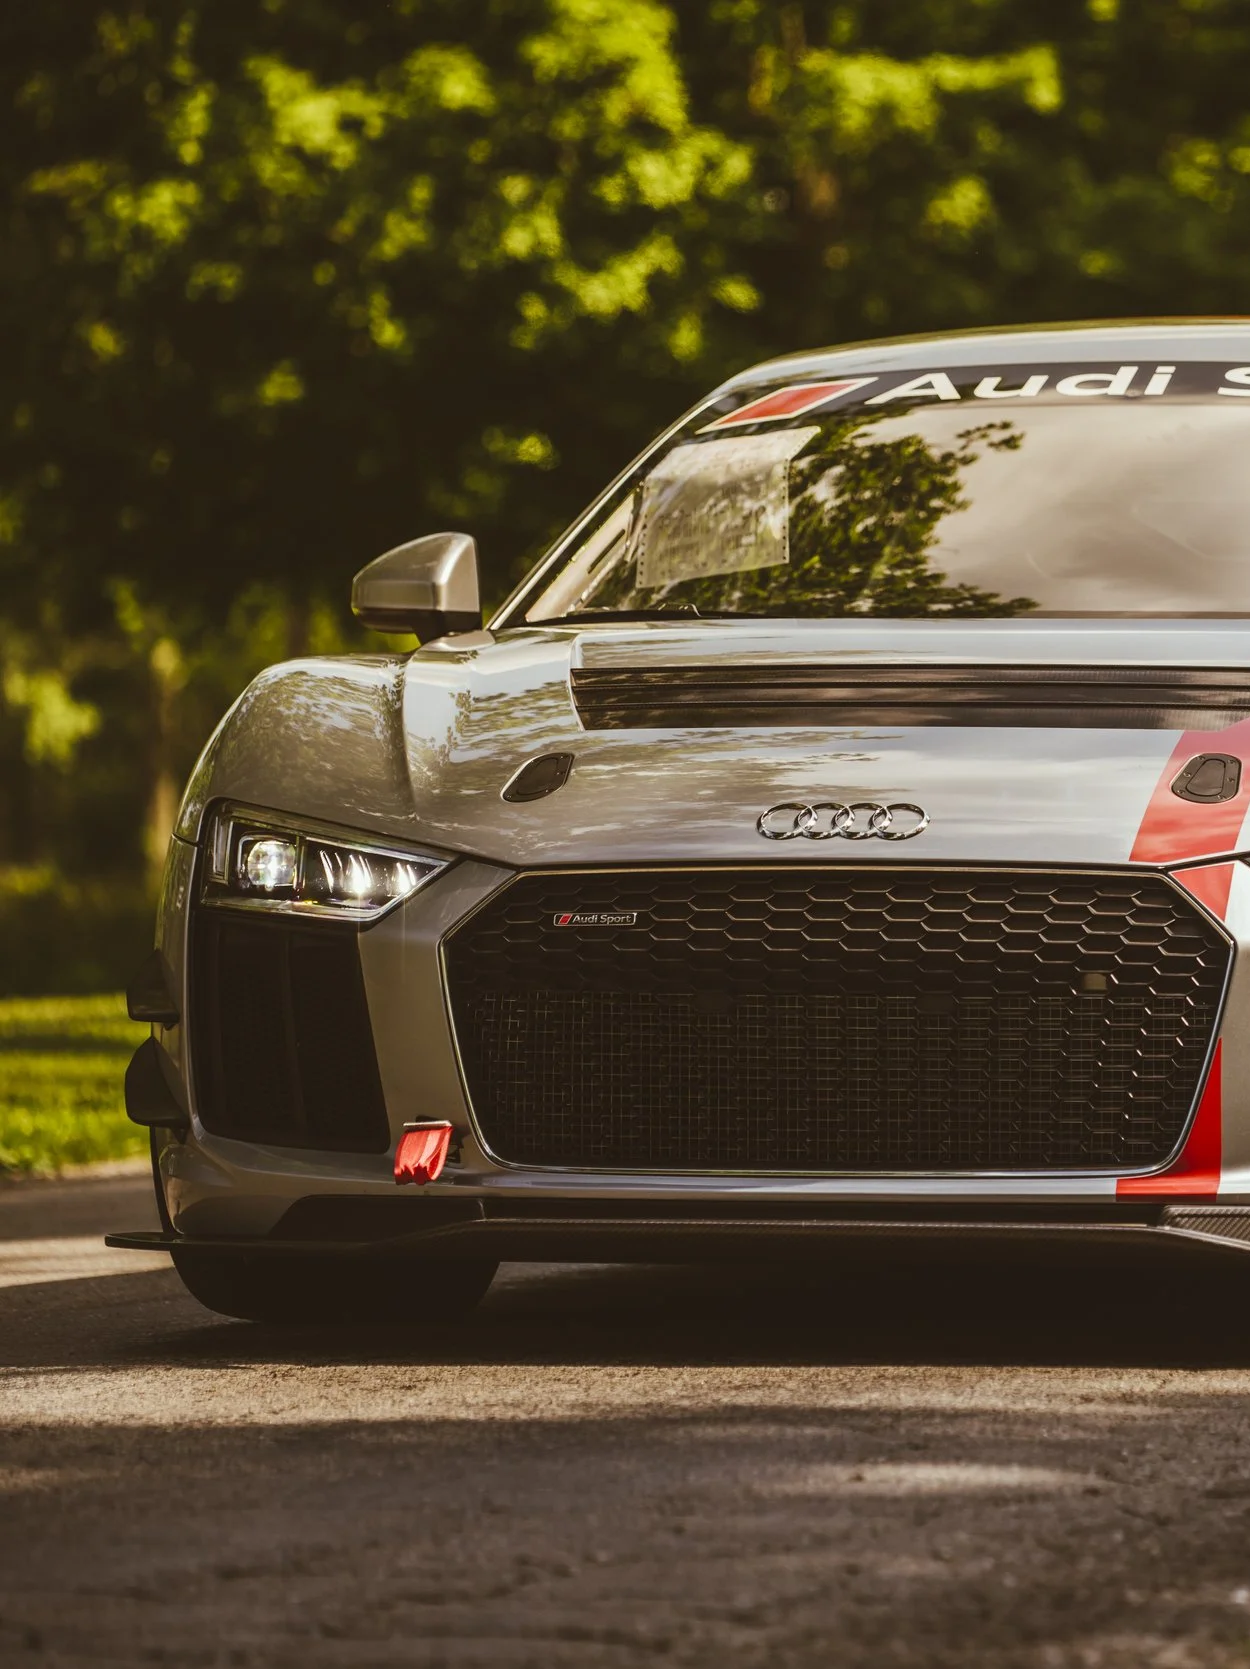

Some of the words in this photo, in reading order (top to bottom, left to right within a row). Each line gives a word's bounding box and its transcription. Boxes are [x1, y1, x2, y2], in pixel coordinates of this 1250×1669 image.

[864, 365, 1177, 405] Audi
[572, 914, 598, 924] Audi
[600, 914, 631, 925] Sport
